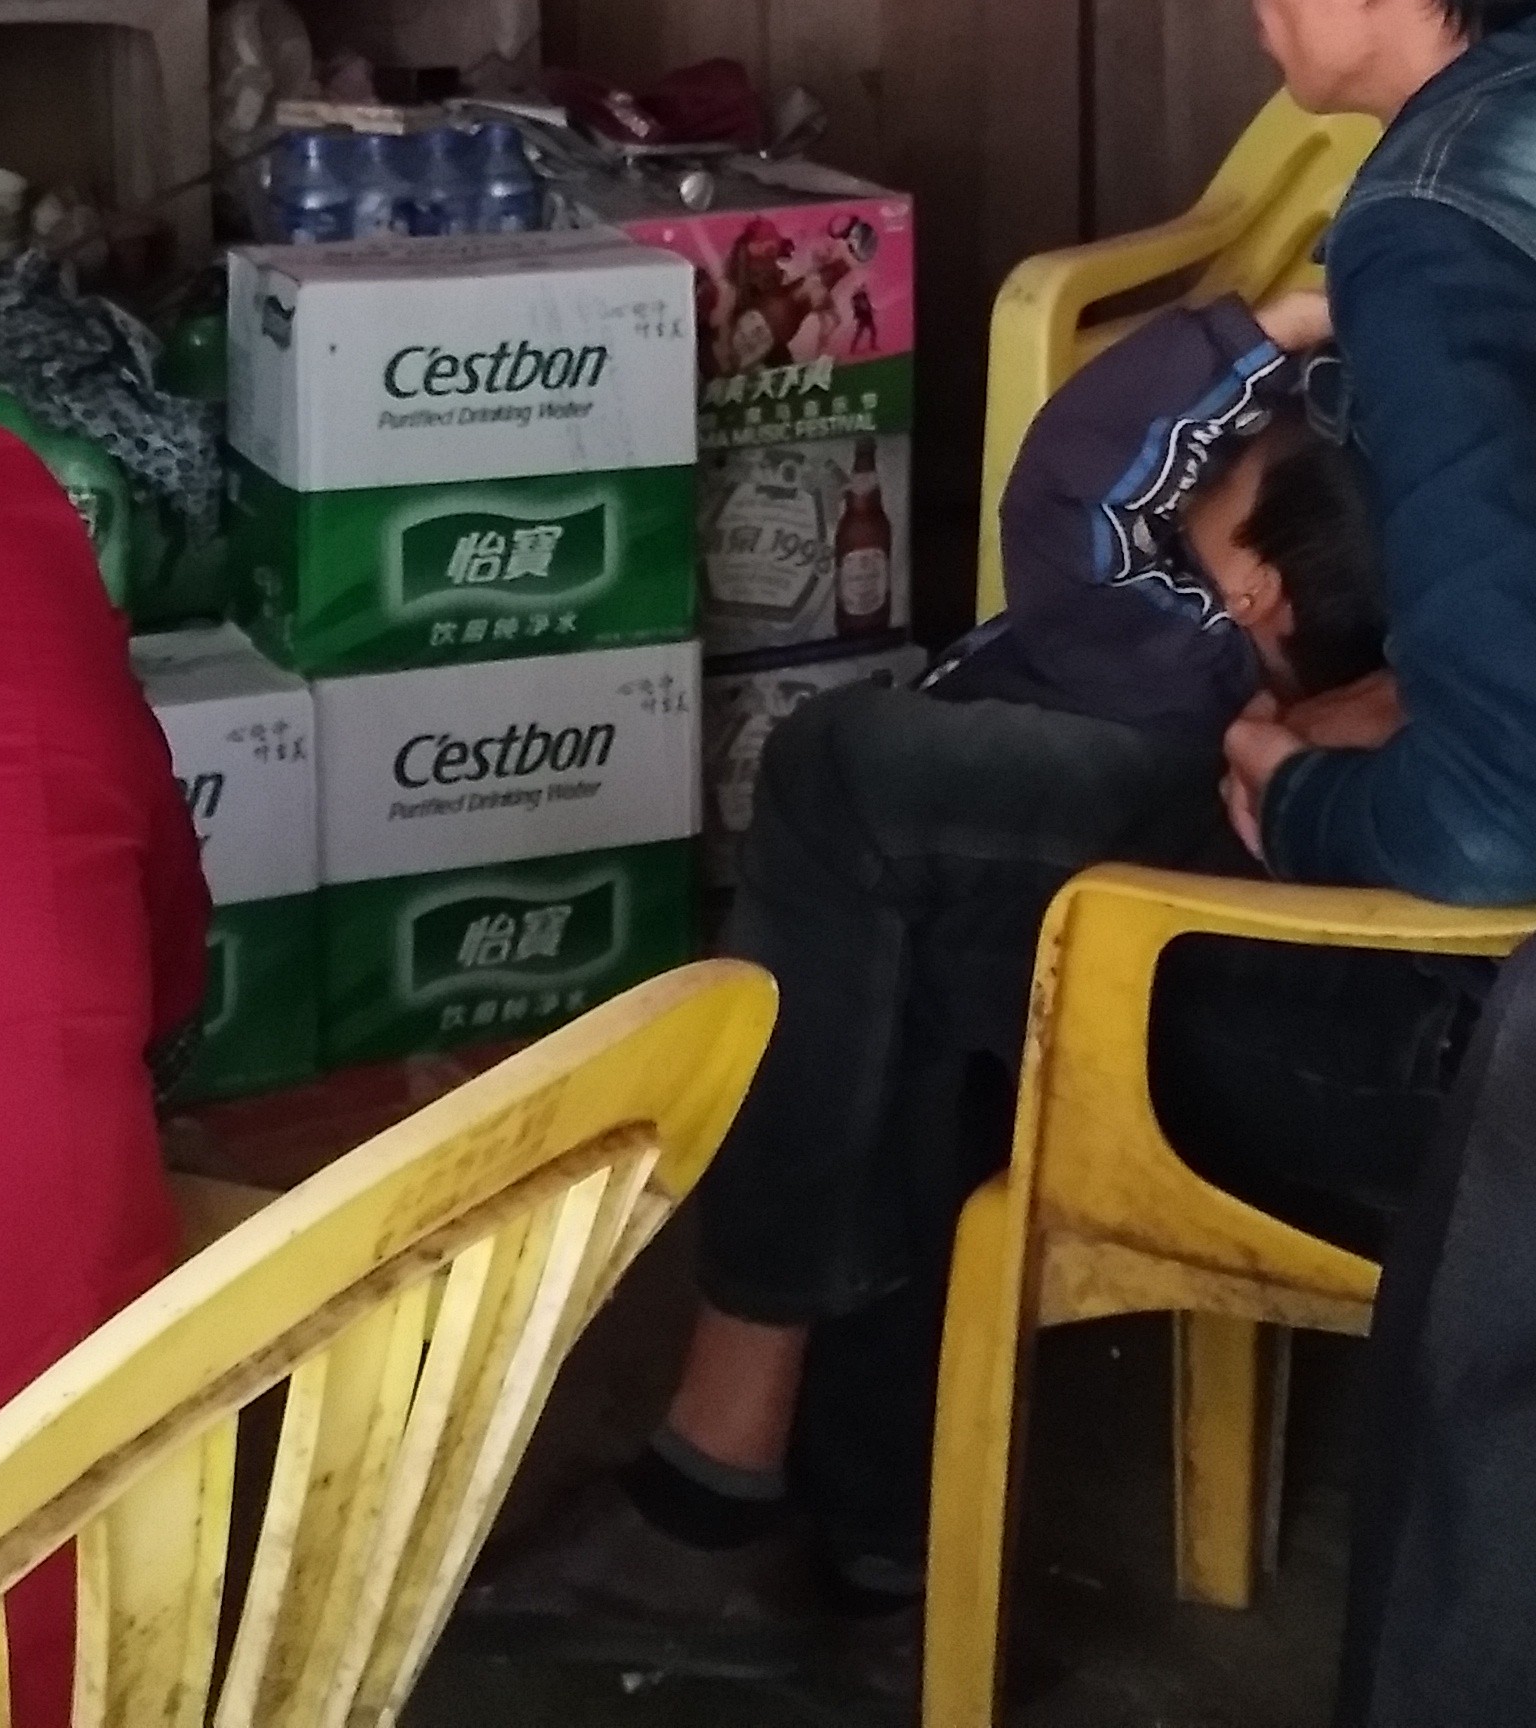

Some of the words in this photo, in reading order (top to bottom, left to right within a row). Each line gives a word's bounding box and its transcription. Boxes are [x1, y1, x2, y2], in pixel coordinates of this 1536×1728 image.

[378, 408, 453, 430] Purified
[458, 403, 531, 428] Drinking
[538, 400, 595, 419] Water
[795, 412, 877, 439] FESTIVAL
[447, 524, 565, 584] 怡寶
[467, 787, 542, 813] Drinking
[547, 781, 602, 801] Water
[457, 905, 572, 967] 怡寶
